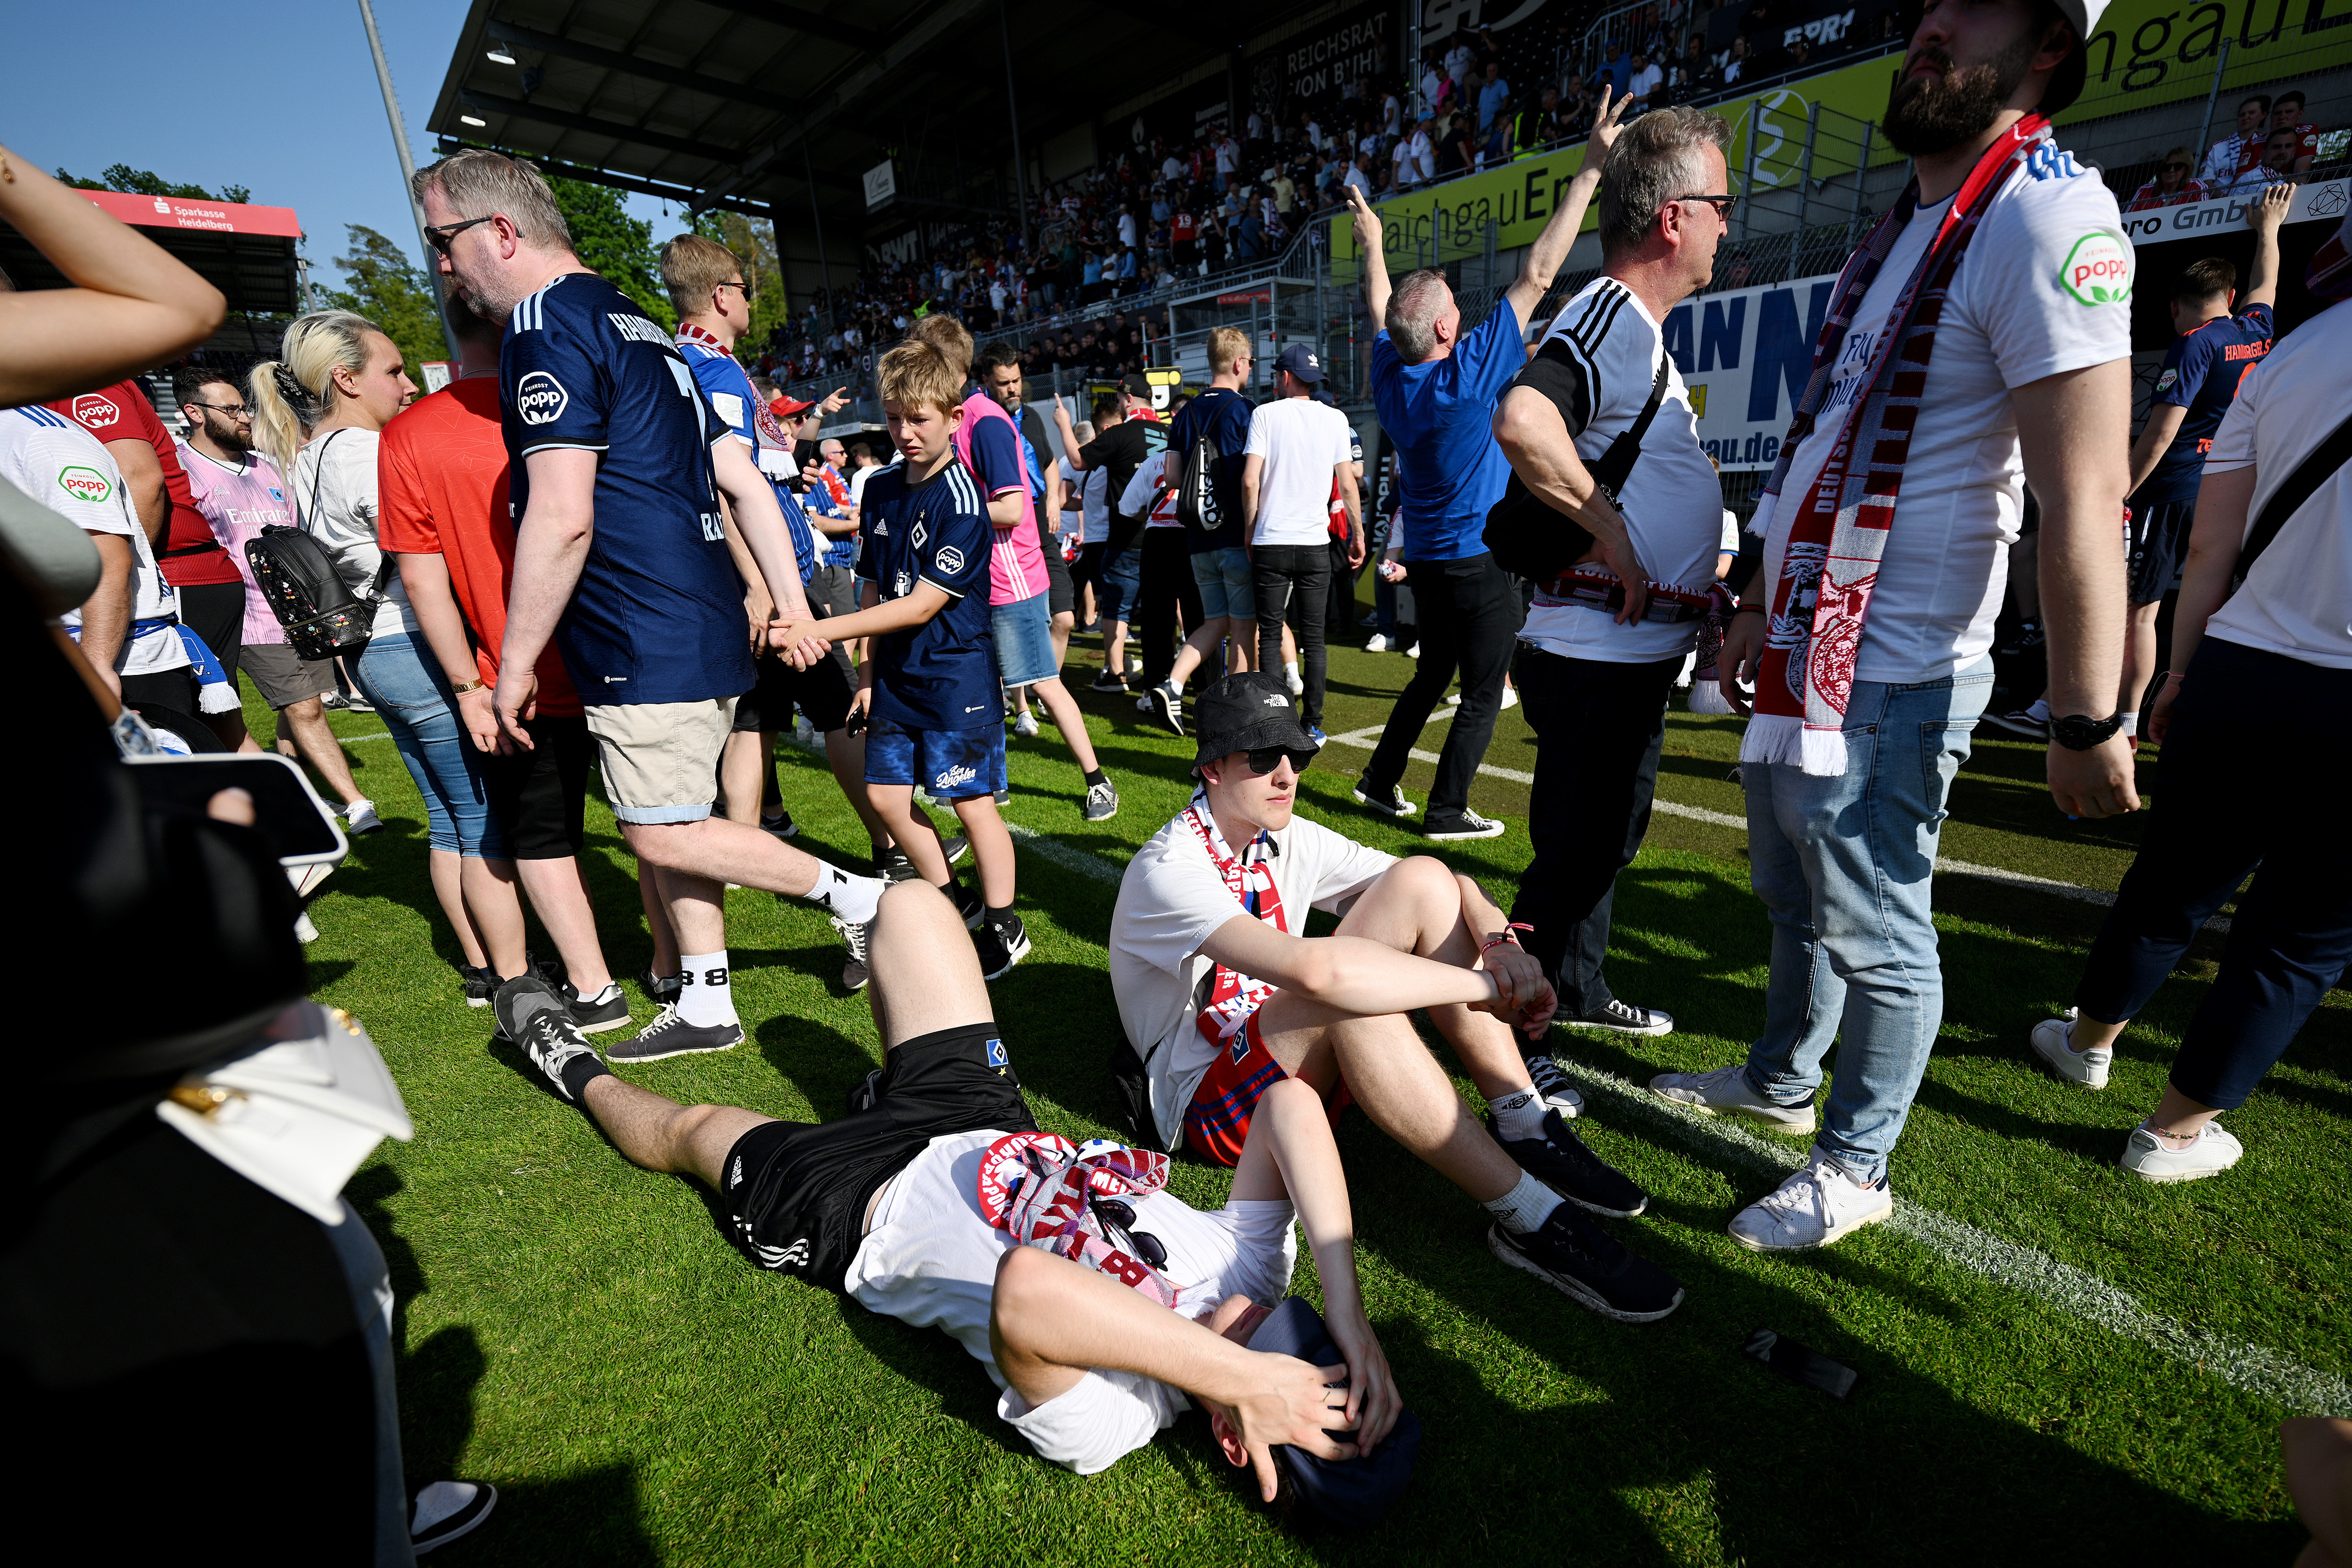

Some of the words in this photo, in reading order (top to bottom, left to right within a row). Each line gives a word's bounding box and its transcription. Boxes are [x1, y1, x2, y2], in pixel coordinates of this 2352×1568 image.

[1287, 11, 1388, 76] REICHSRAT
[174, 206, 226, 219] Sparkasse
[2173, 197, 2253, 230] Gmb
[178, 217, 235, 232] Heidelberg
[2074, 260, 2129, 288] popp
[525, 383, 549, 392] FEINKOST
[80, 400, 101, 408] FEINKOST
[520, 392, 562, 413] popp
[78, 404, 114, 421] popp
[1699, 432, 1780, 464] au.de
[66, 479, 106, 493] popp
[874, 528, 888, 536] adidas
[938, 553, 961, 569] popp
[936, 767, 977, 788] Angeles
[730, 1155, 741, 1189] adidas
